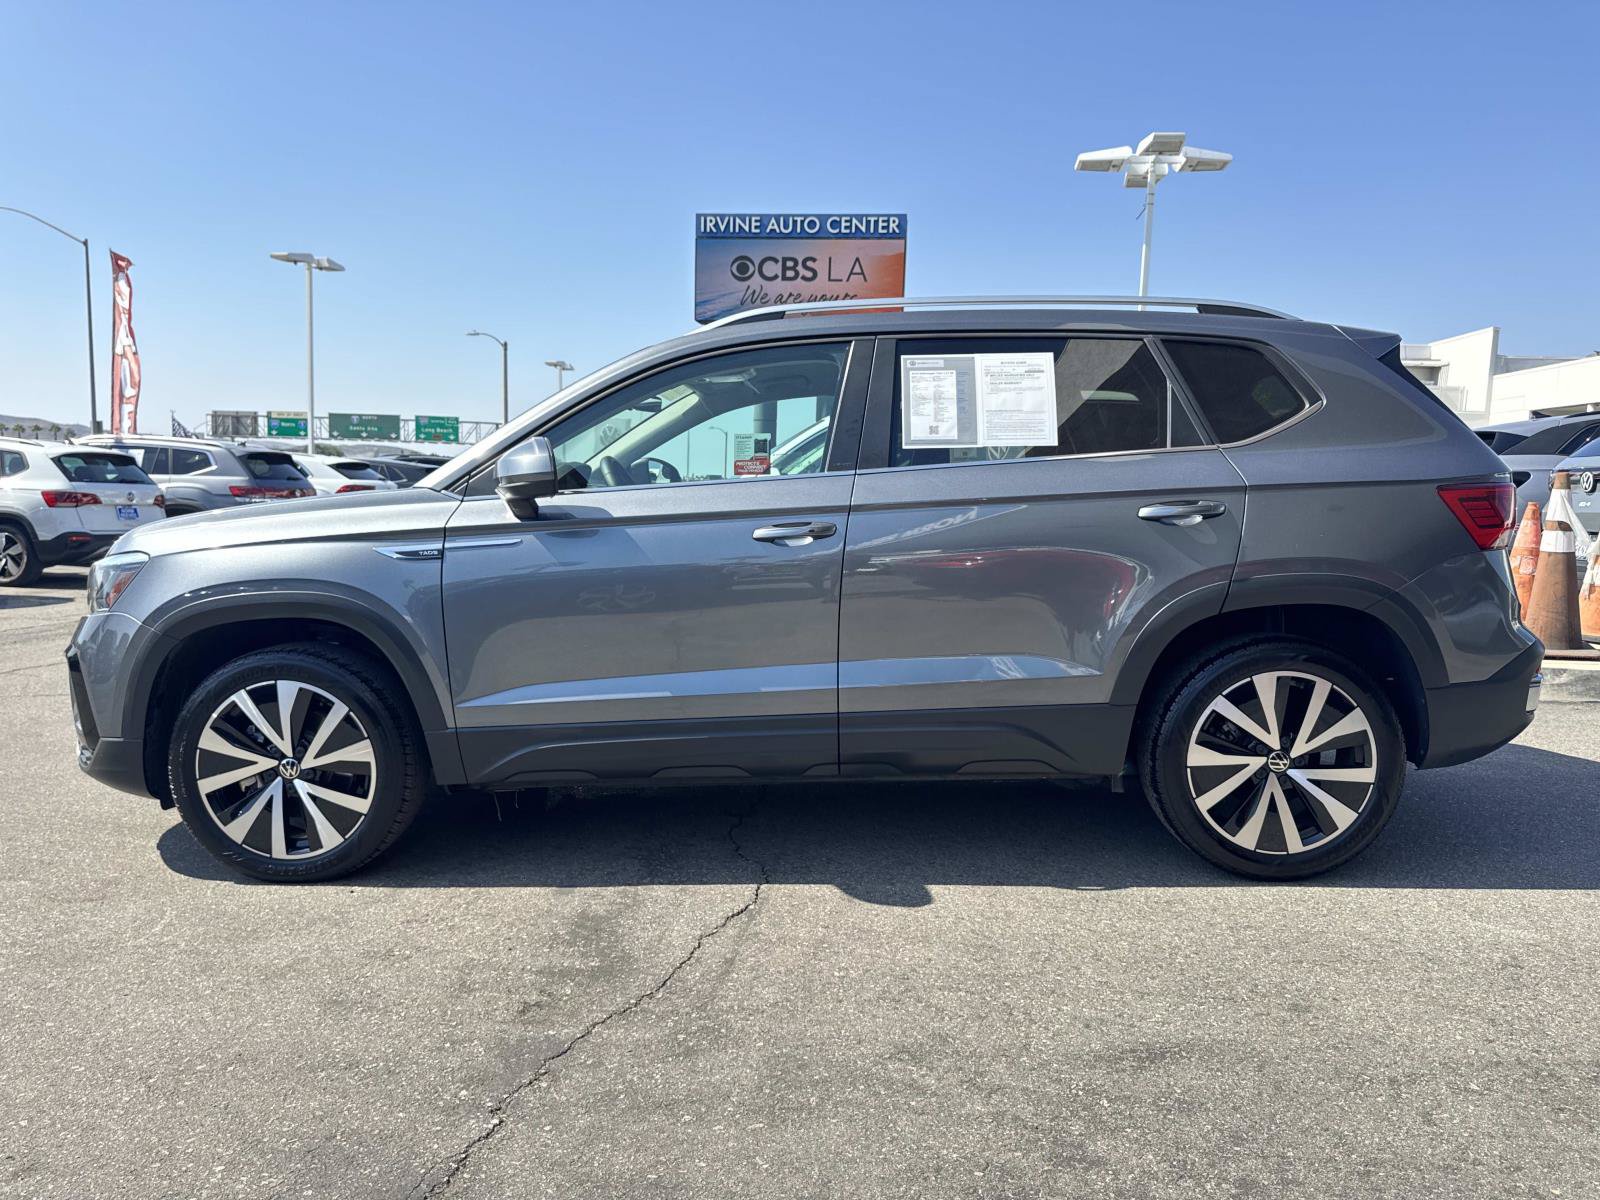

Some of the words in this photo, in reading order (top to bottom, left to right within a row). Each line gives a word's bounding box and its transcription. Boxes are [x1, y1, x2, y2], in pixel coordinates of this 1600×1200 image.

[700, 216, 761, 234] IRVINE
[766, 216, 820, 234] AUTO
[826, 216, 900, 234] CENTER
[757, 255, 818, 282] CBS
[827, 256, 868, 282] LA
[740, 284, 768, 307] We
[773, 292, 802, 305] are
